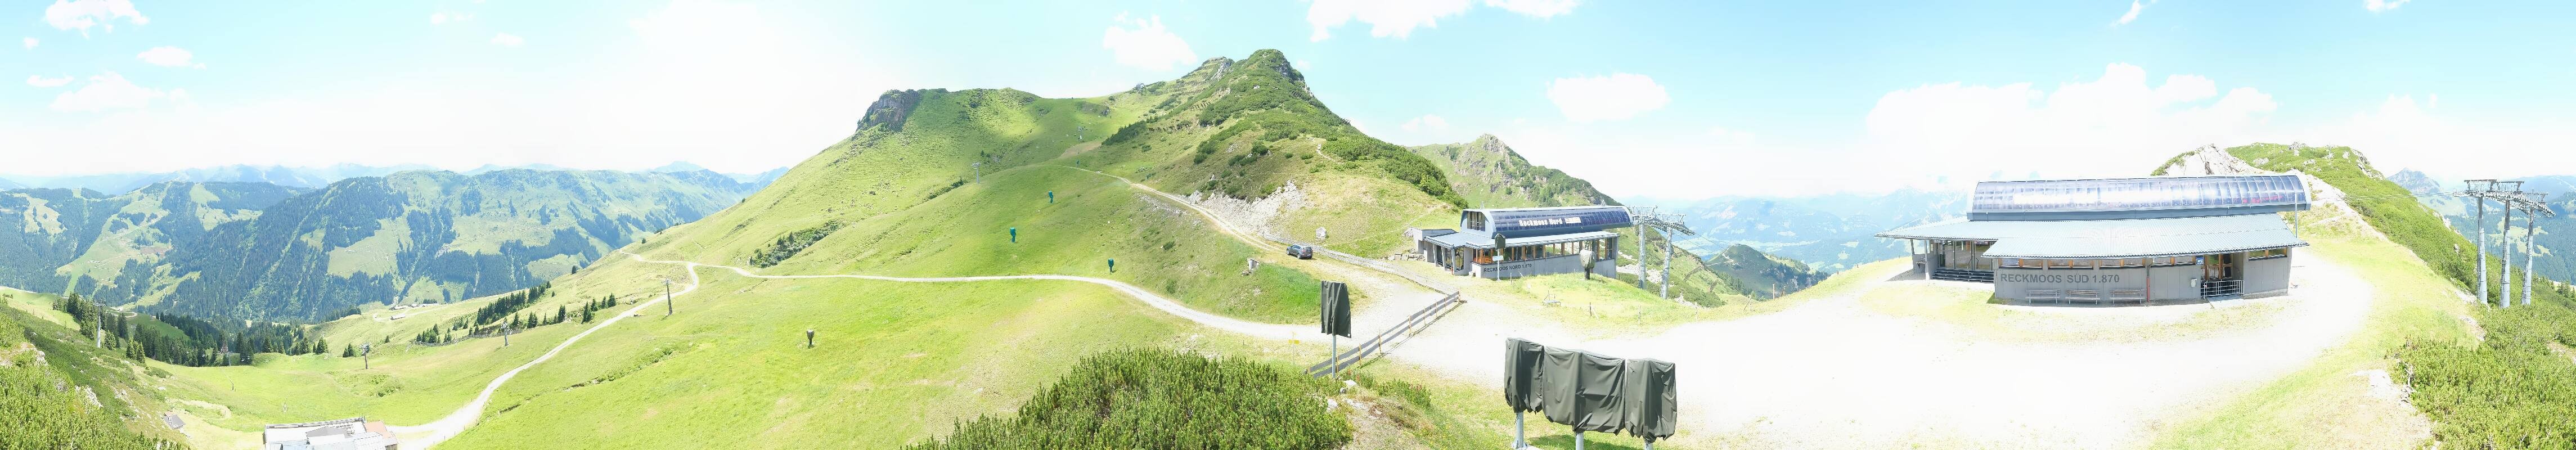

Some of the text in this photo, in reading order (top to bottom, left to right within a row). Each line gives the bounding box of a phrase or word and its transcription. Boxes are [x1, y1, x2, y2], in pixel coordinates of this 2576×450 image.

[2000, 273, 2120, 283] RECKMOOS SÜD 1.870
